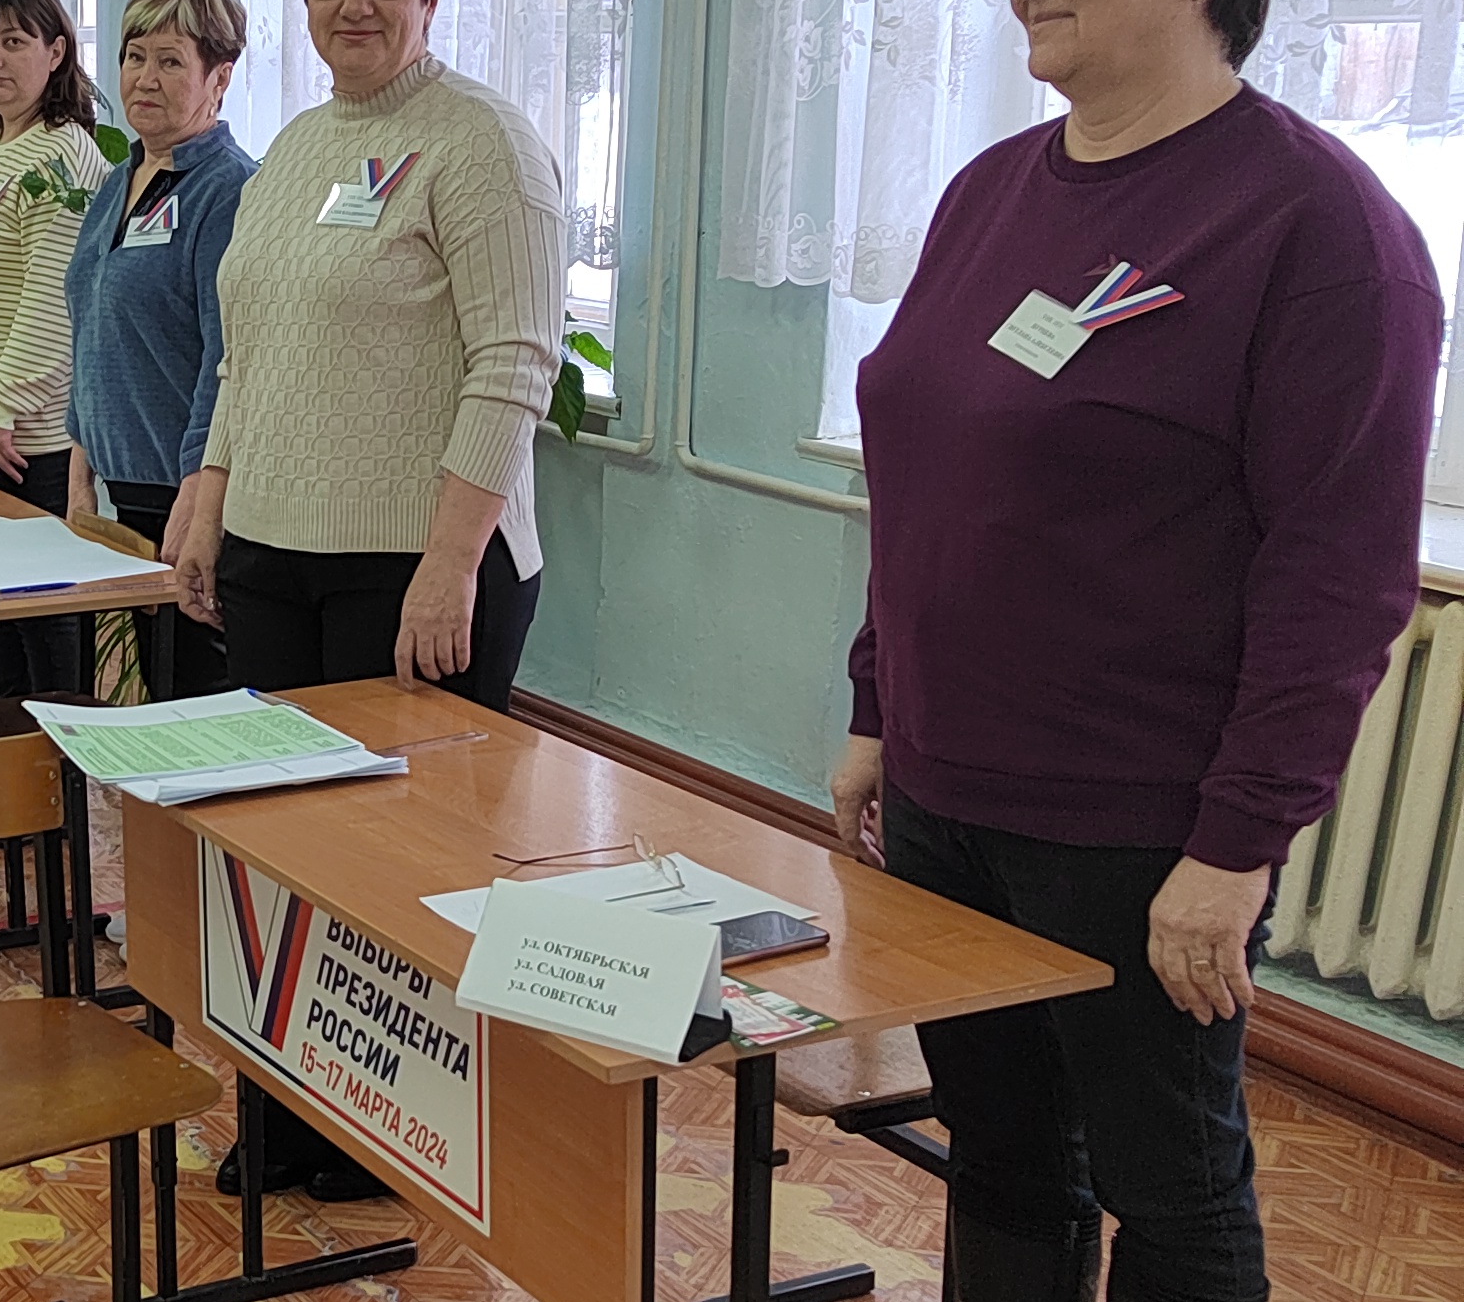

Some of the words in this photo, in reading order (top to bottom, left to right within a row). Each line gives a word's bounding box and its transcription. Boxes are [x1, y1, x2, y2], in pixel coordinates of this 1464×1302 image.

[325, 915, 434, 1001] ВЫБОРЫ
[507, 978, 527, 992] ул.
[530, 982, 618, 1017] СОВЕТСКАЯ
[514, 957, 534, 971] ул.
[536, 961, 606, 990] САДОВАЯ
[520, 937, 541, 950] ул.
[543, 940, 651, 980] ОКТЯБРЬСКАЯ
[306, 997, 402, 1088] РОССИИ
[316, 952, 471, 1082] ПРЕЗИДЕНТА
[343, 1072, 403, 1139] МАРТА
[402, 1115, 449, 1170] 2024
